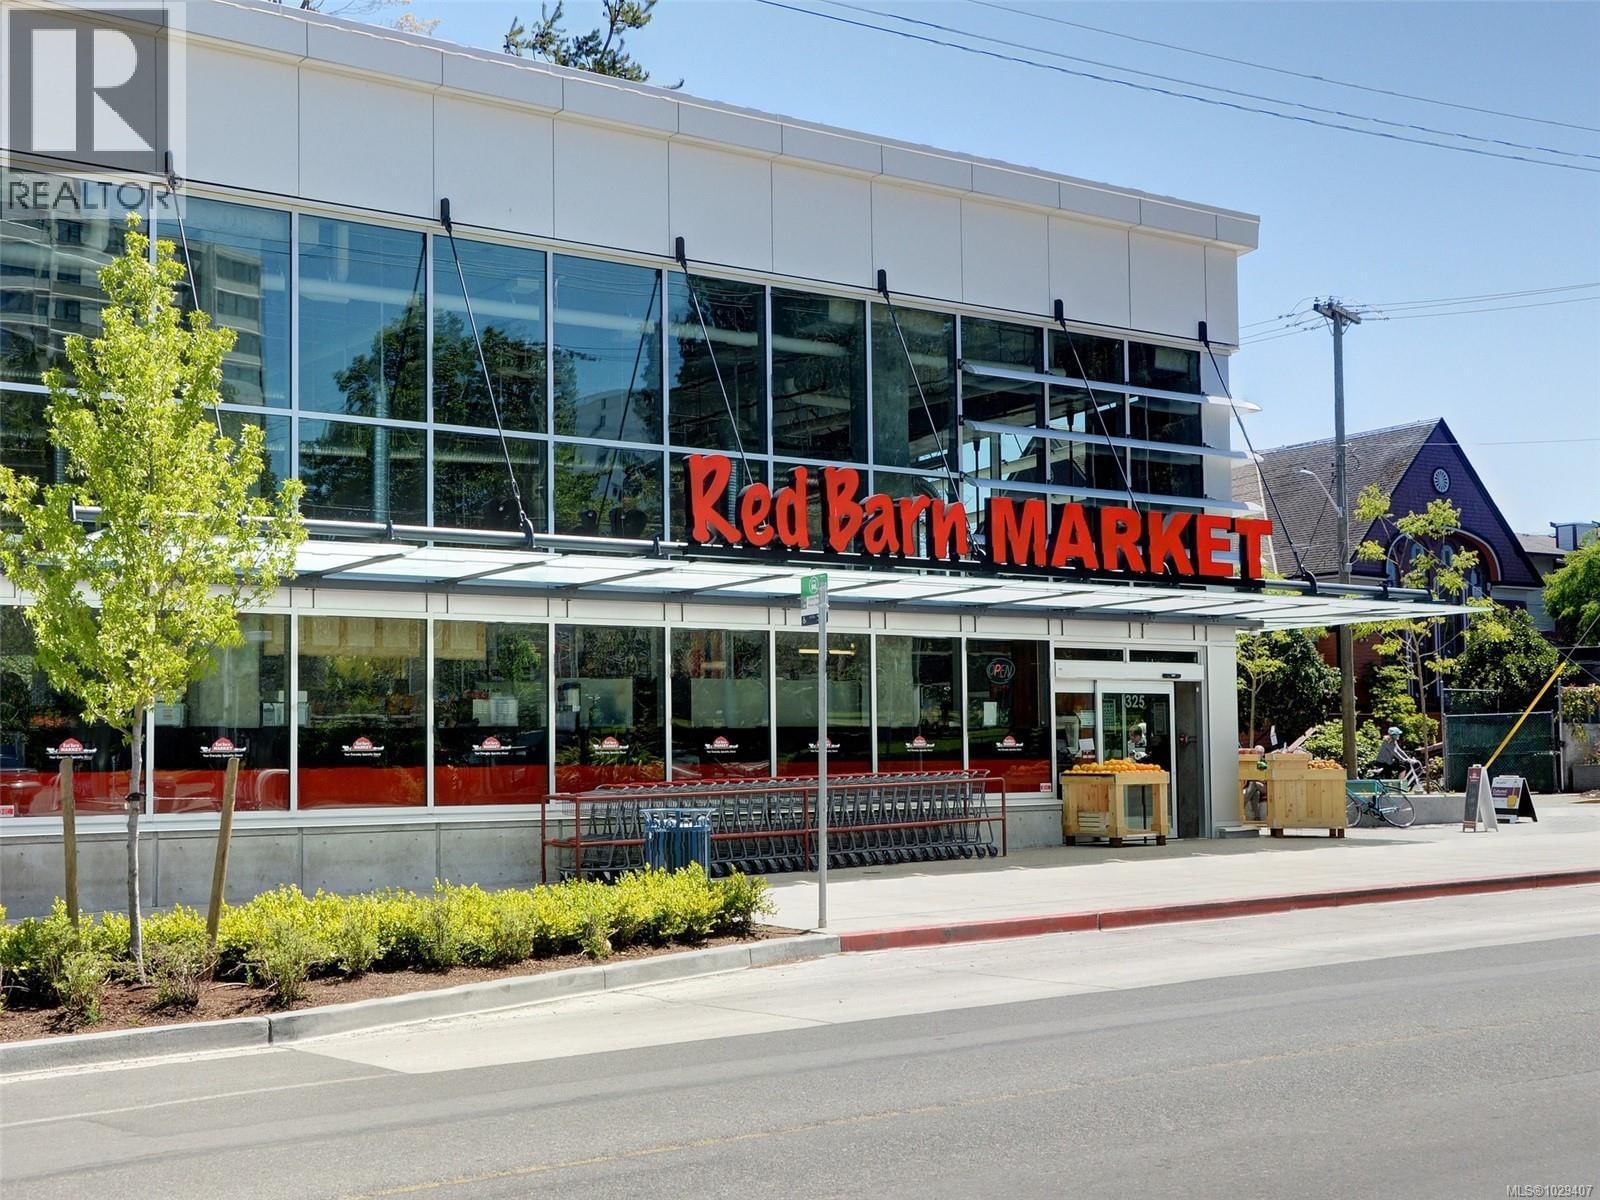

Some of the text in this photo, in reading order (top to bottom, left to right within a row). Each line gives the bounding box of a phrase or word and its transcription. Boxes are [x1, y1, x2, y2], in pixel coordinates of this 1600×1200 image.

[688, 453, 1273, 579] Red Barn MARKET
[1125, 694, 1146, 709] 325
